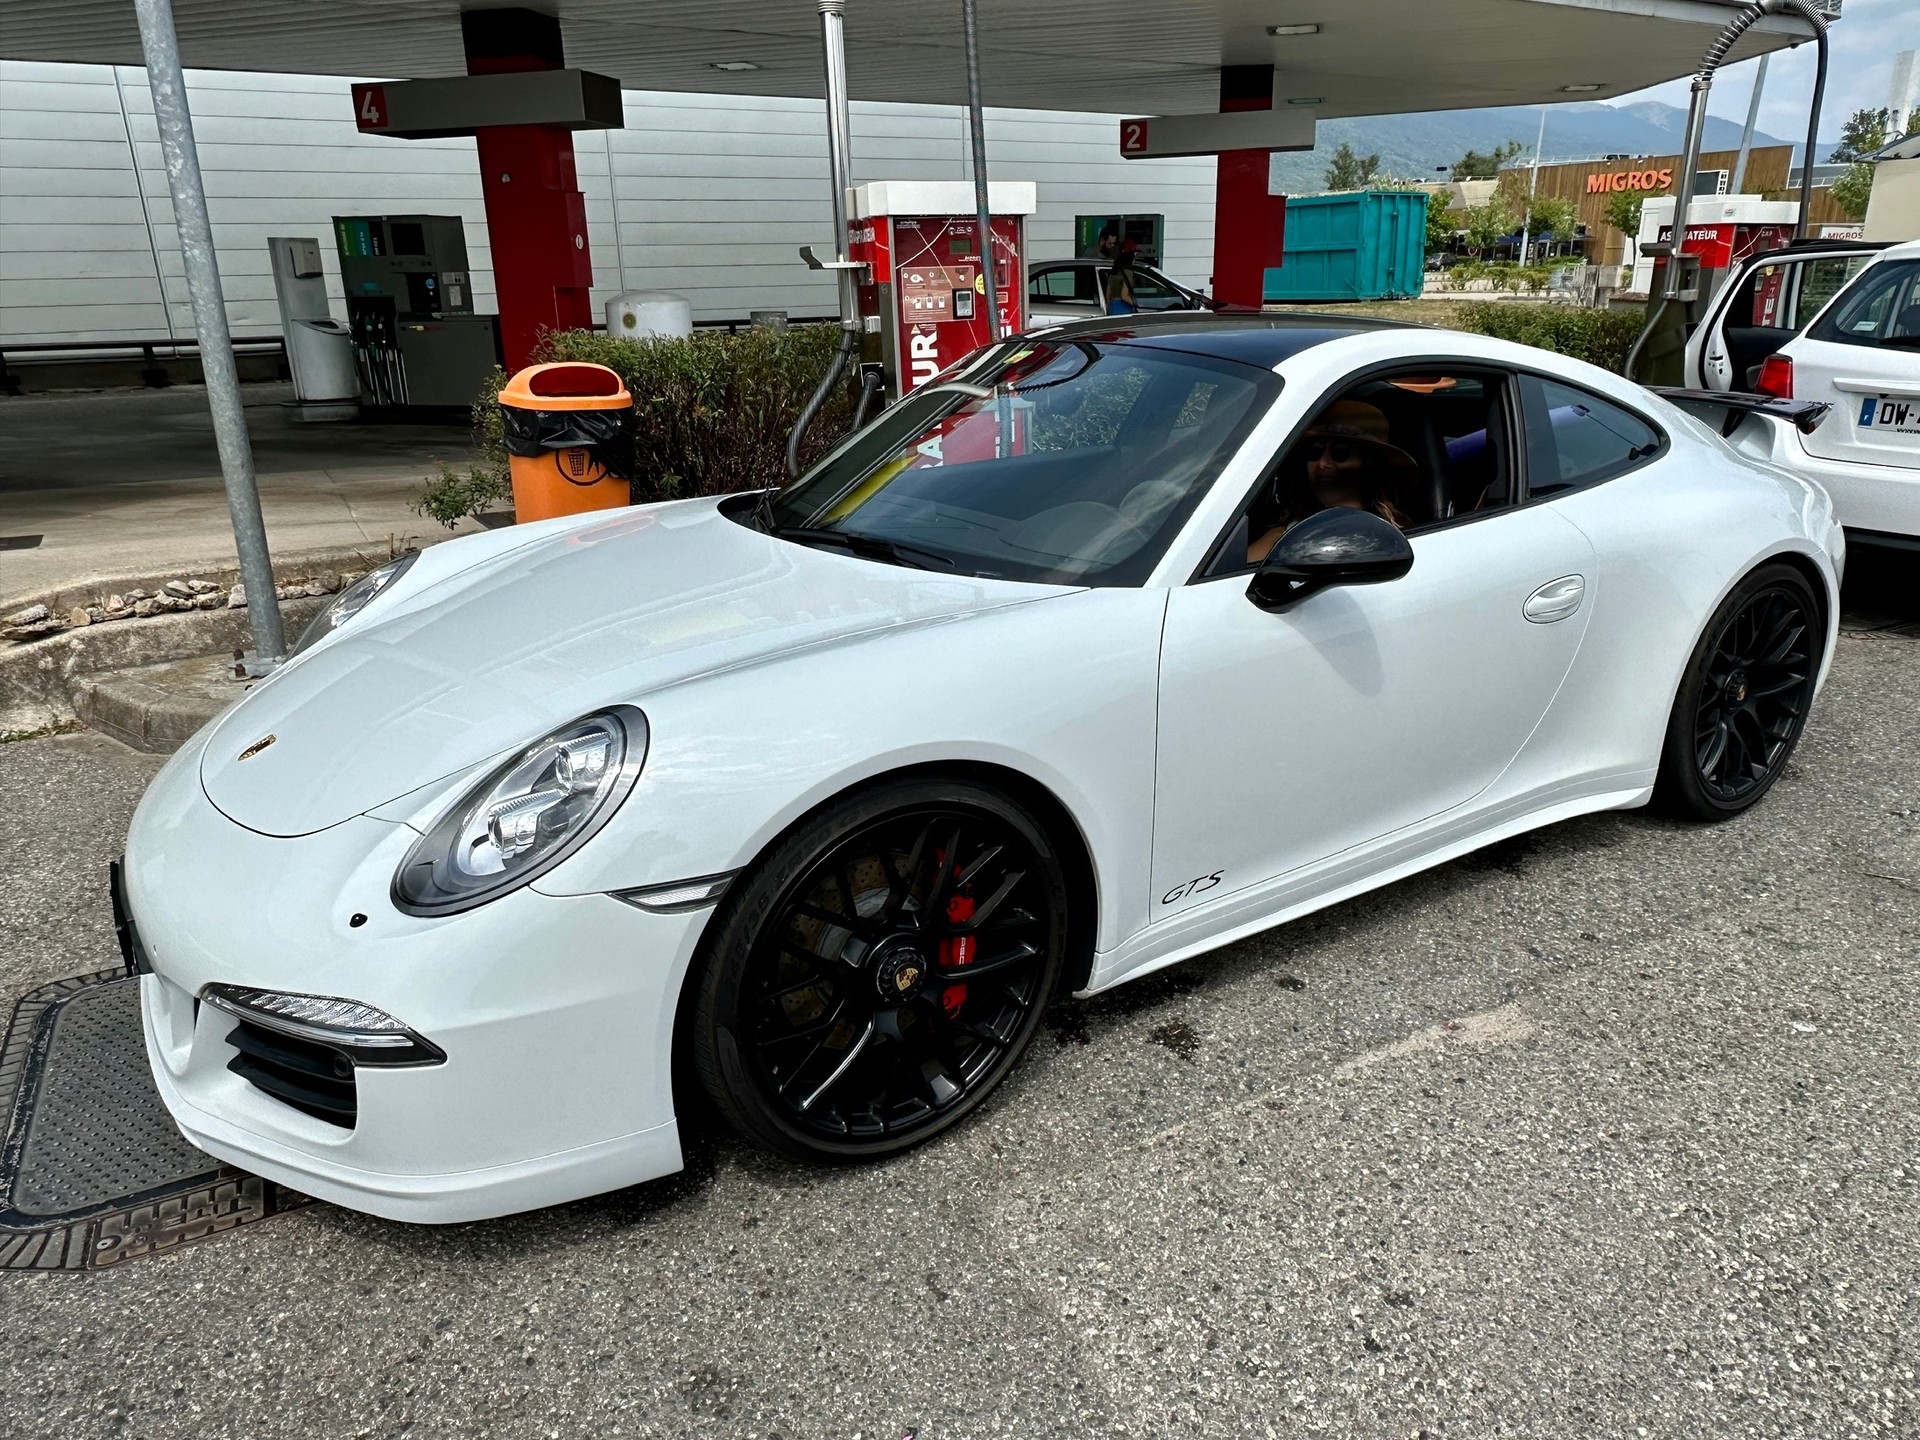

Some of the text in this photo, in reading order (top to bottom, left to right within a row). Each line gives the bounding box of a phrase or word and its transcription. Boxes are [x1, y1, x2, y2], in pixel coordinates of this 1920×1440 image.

[362, 91, 380, 124] 4
[1126, 124, 1141, 149] 2
[1586, 168, 1673, 193] MIGROS
[1660, 230, 1718, 242] ASATEUR
[1827, 231, 1864, 240] MIGROS
[1879, 402, 1920, 426] DW-
[1161, 869, 1225, 905] GTS
